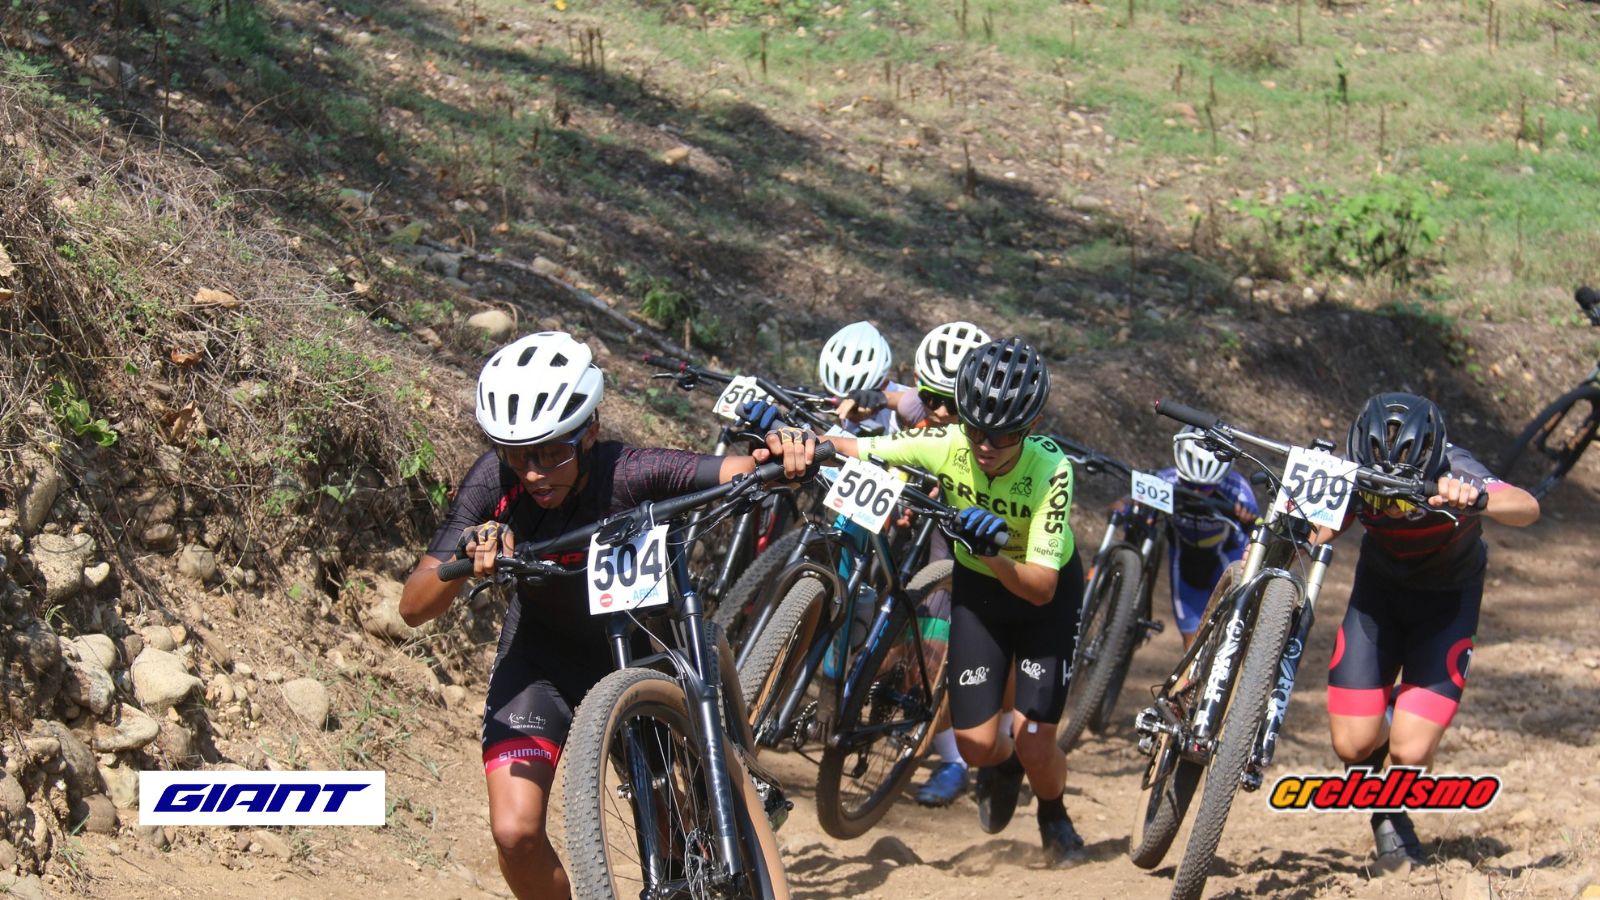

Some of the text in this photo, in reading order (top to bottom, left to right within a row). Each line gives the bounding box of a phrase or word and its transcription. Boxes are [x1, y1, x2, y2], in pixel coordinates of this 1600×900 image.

[724, 384, 770, 404] 50
[837, 469, 895, 517] 506
[938, 473, 1032, 519] GRECIA
[1043, 471, 1069, 535] ROES
[1136, 480, 1170, 505] 502
[1285, 462, 1348, 511] 509
[593, 538, 663, 592] 504
